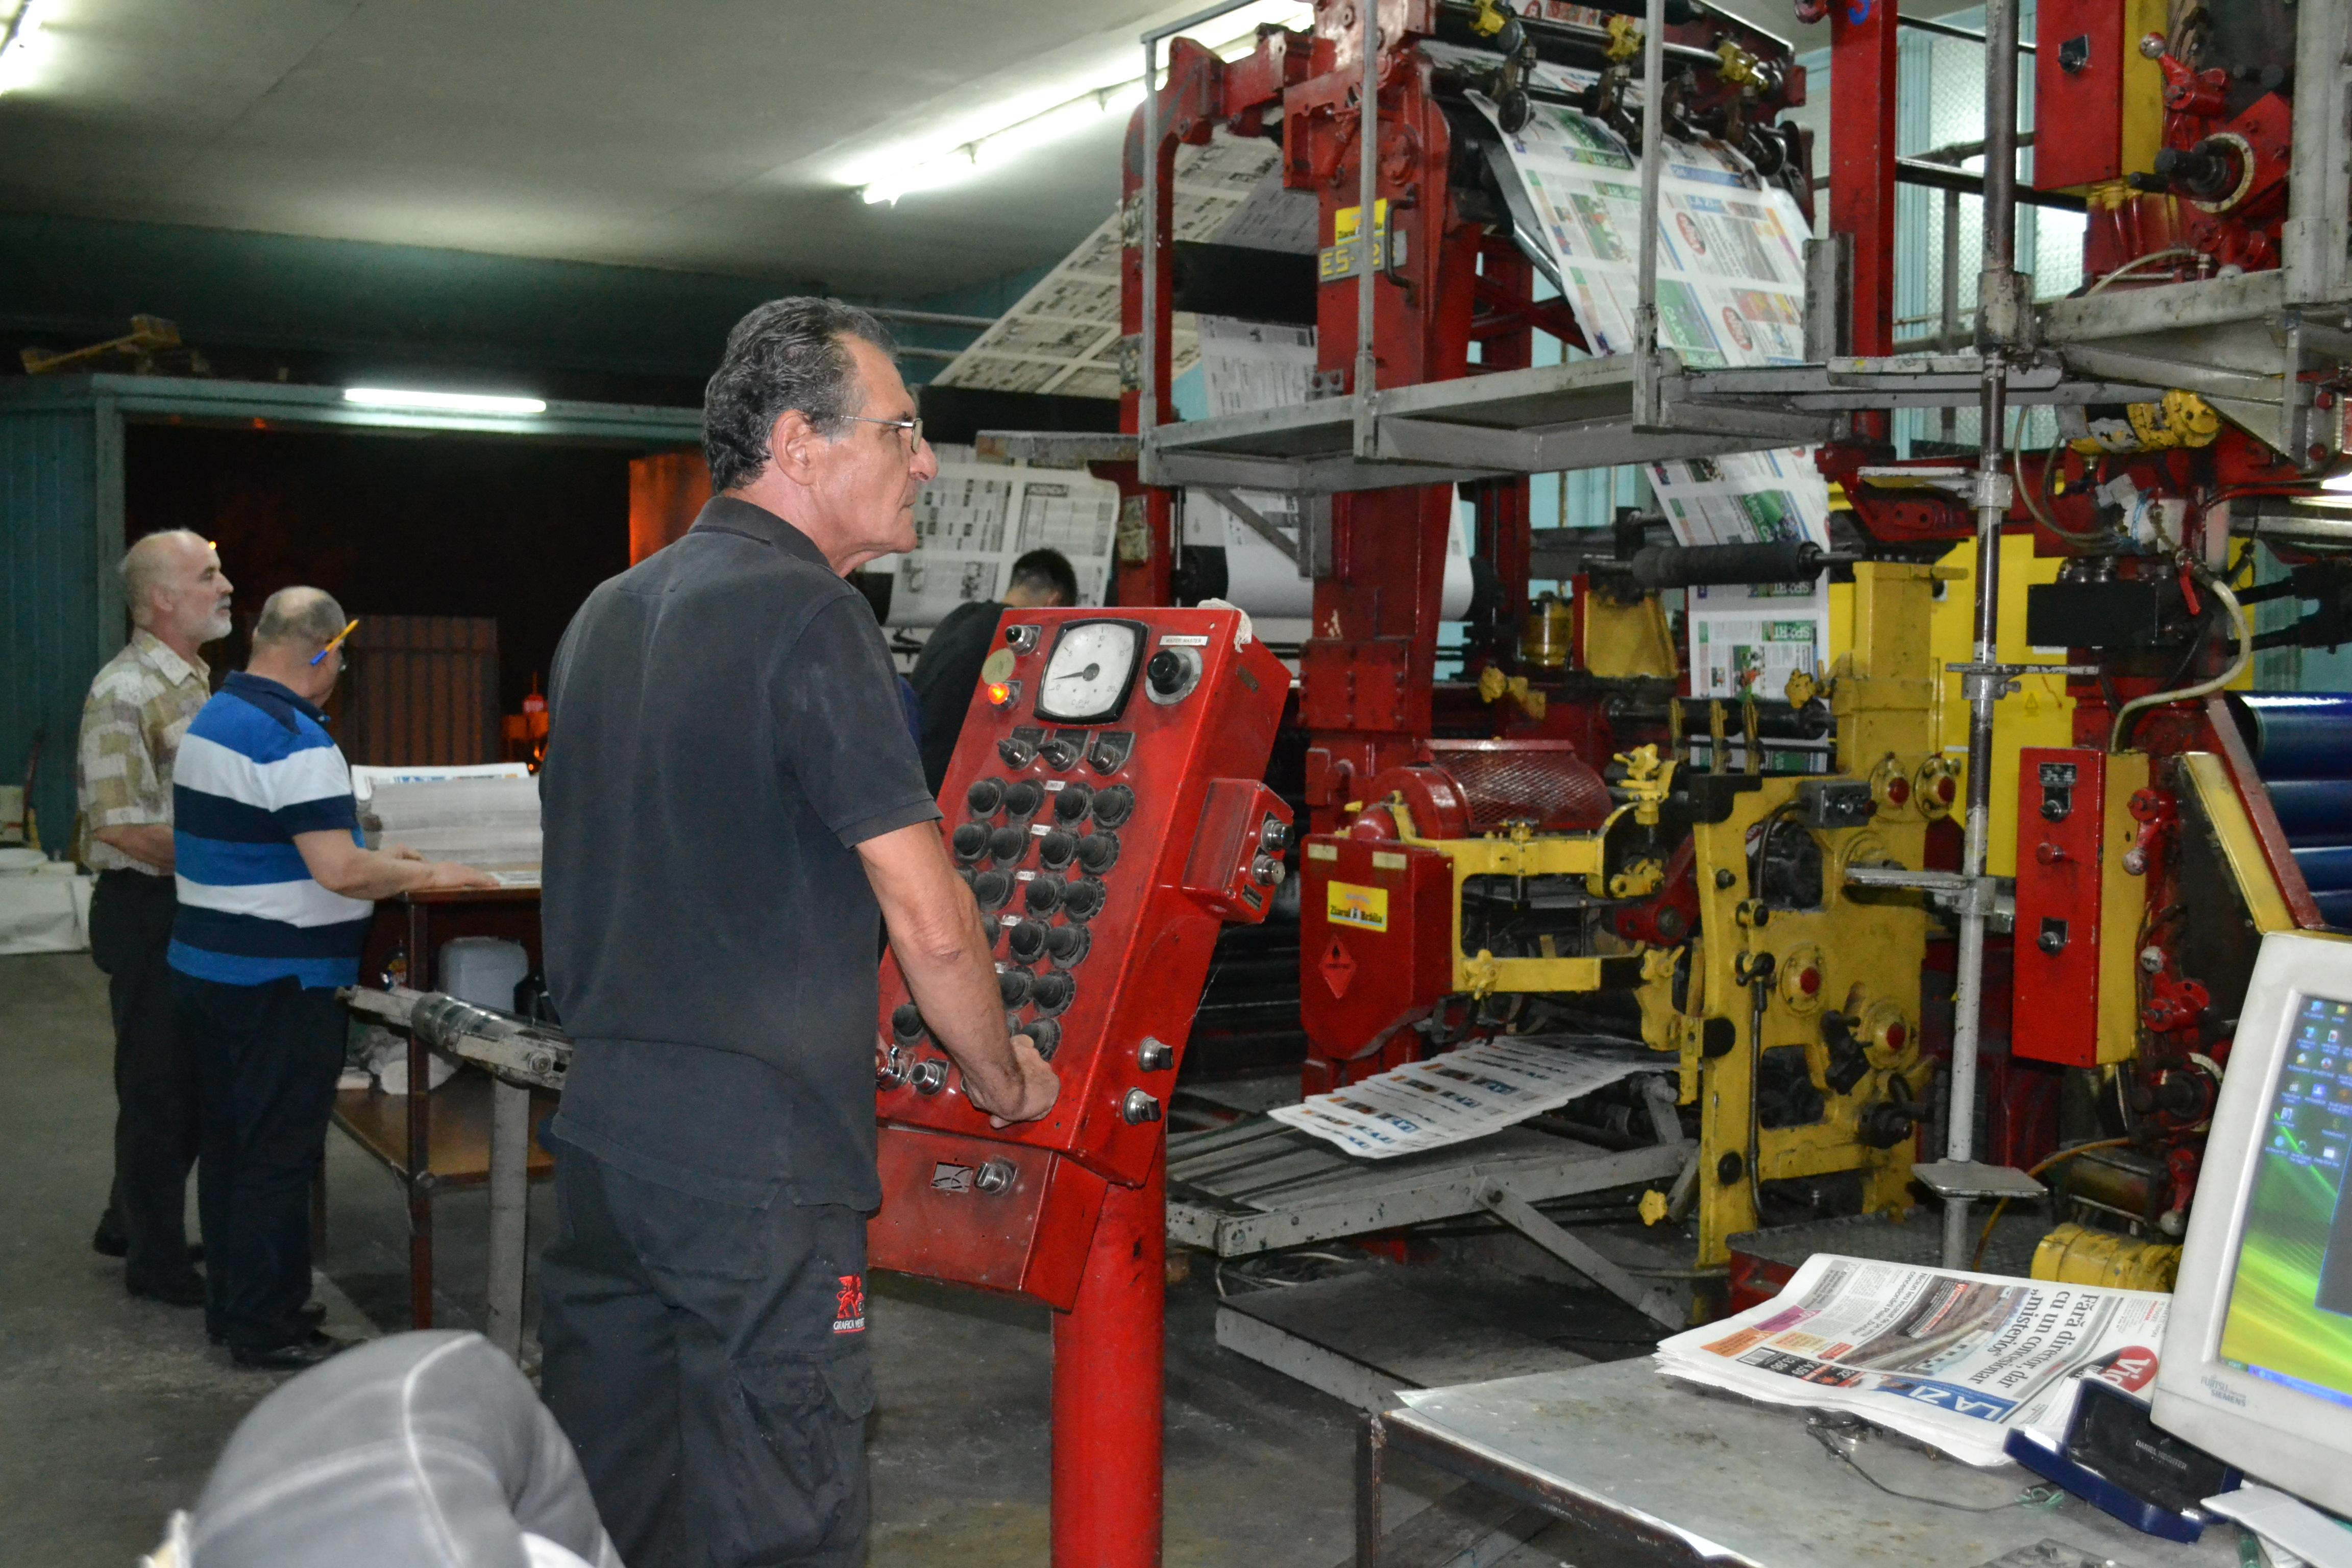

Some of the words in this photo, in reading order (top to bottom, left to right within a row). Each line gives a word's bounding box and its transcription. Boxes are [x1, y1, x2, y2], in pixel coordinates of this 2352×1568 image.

[2050, 1290, 2071, 1310] cu
[2067, 1292, 2100, 1328] Fără
[2038, 1312, 2060, 1330] un
[1967, 1332, 2042, 1384] concesionar
[1996, 1370, 2028, 1389] dar
[2200, 1375, 2228, 1391] FUJITSU
[1908, 1385, 1951, 1405] ZI
[2210, 1389, 2246, 1407] SIEMENS
[1955, 1397, 2005, 1421] LA
[2135, 1439, 2157, 1456] DANIEL
